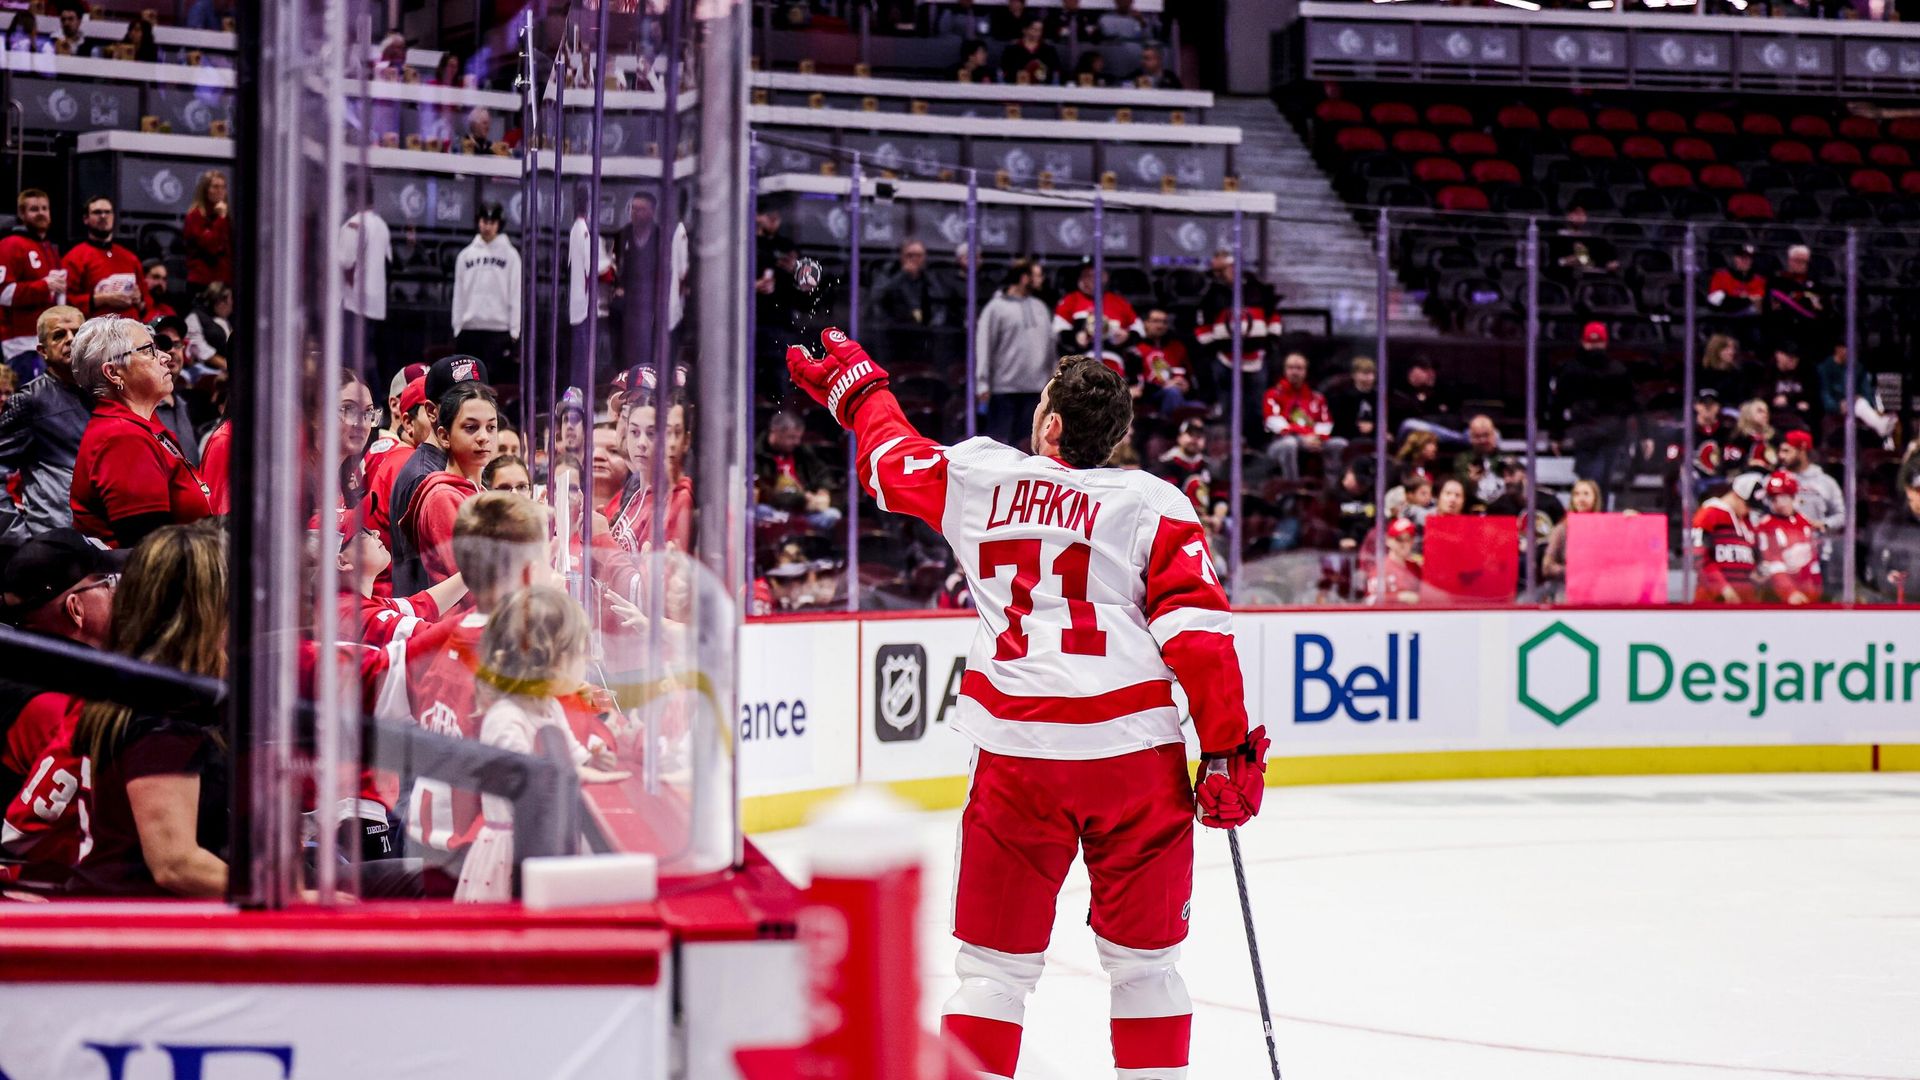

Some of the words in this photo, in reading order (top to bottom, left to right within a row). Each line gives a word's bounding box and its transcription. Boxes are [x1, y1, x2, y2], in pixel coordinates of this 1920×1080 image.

[986, 480, 1101, 541] LARKIN
[979, 539, 1107, 661] 71
[1294, 632, 1419, 723] Bell
[20, 755, 79, 820] 13
